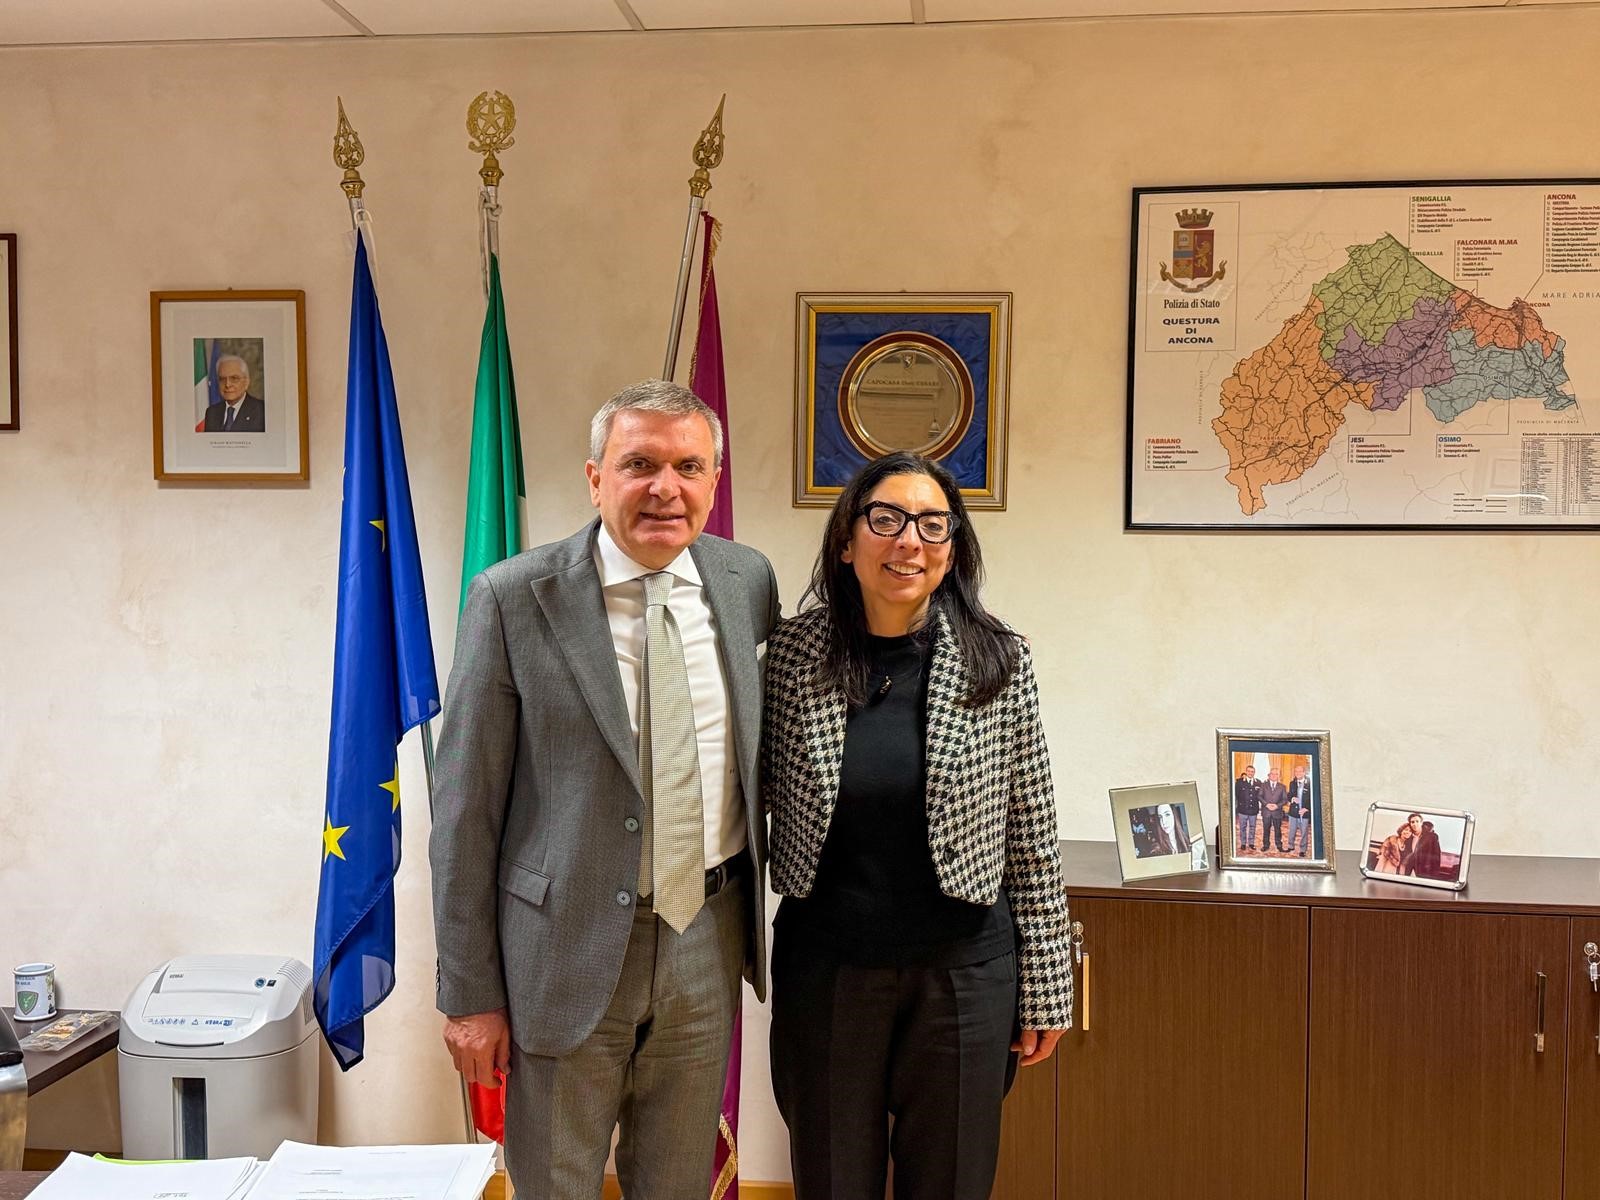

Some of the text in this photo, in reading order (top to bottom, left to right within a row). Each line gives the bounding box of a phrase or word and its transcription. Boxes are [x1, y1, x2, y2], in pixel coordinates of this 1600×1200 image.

[1164, 298, 1220, 309] Polizia di Stato
[1162, 317, 1220, 325] QUESTURA
